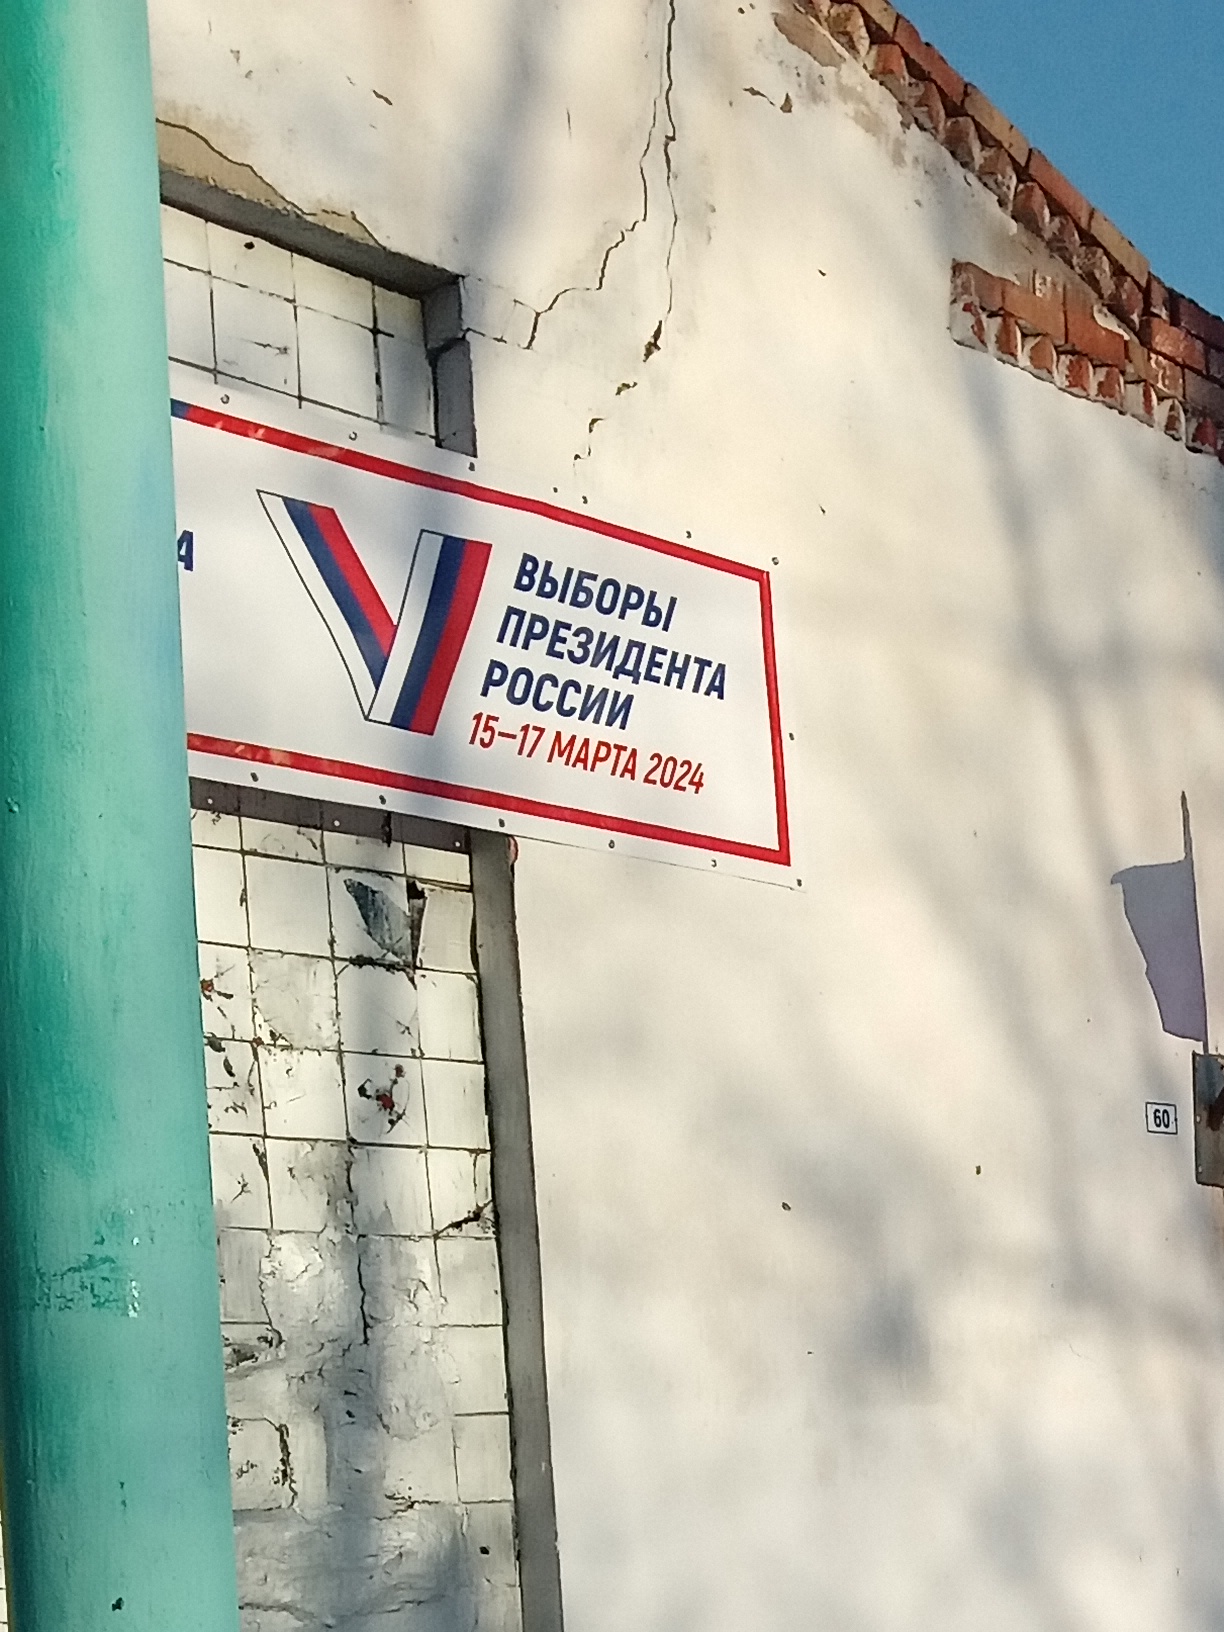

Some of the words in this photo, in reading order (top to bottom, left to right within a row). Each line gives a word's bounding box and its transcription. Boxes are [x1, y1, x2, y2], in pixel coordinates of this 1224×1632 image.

[513, 552, 678, 632] ВЫБОРЫ
[496, 605, 727, 700] ПРЕЗИДЕНТА
[480, 659, 635, 730] РОССИИ
[547, 731, 638, 780] МАРТА
[643, 752, 705, 794] 2024
[1153, 1108, 1170, 1129] 60
